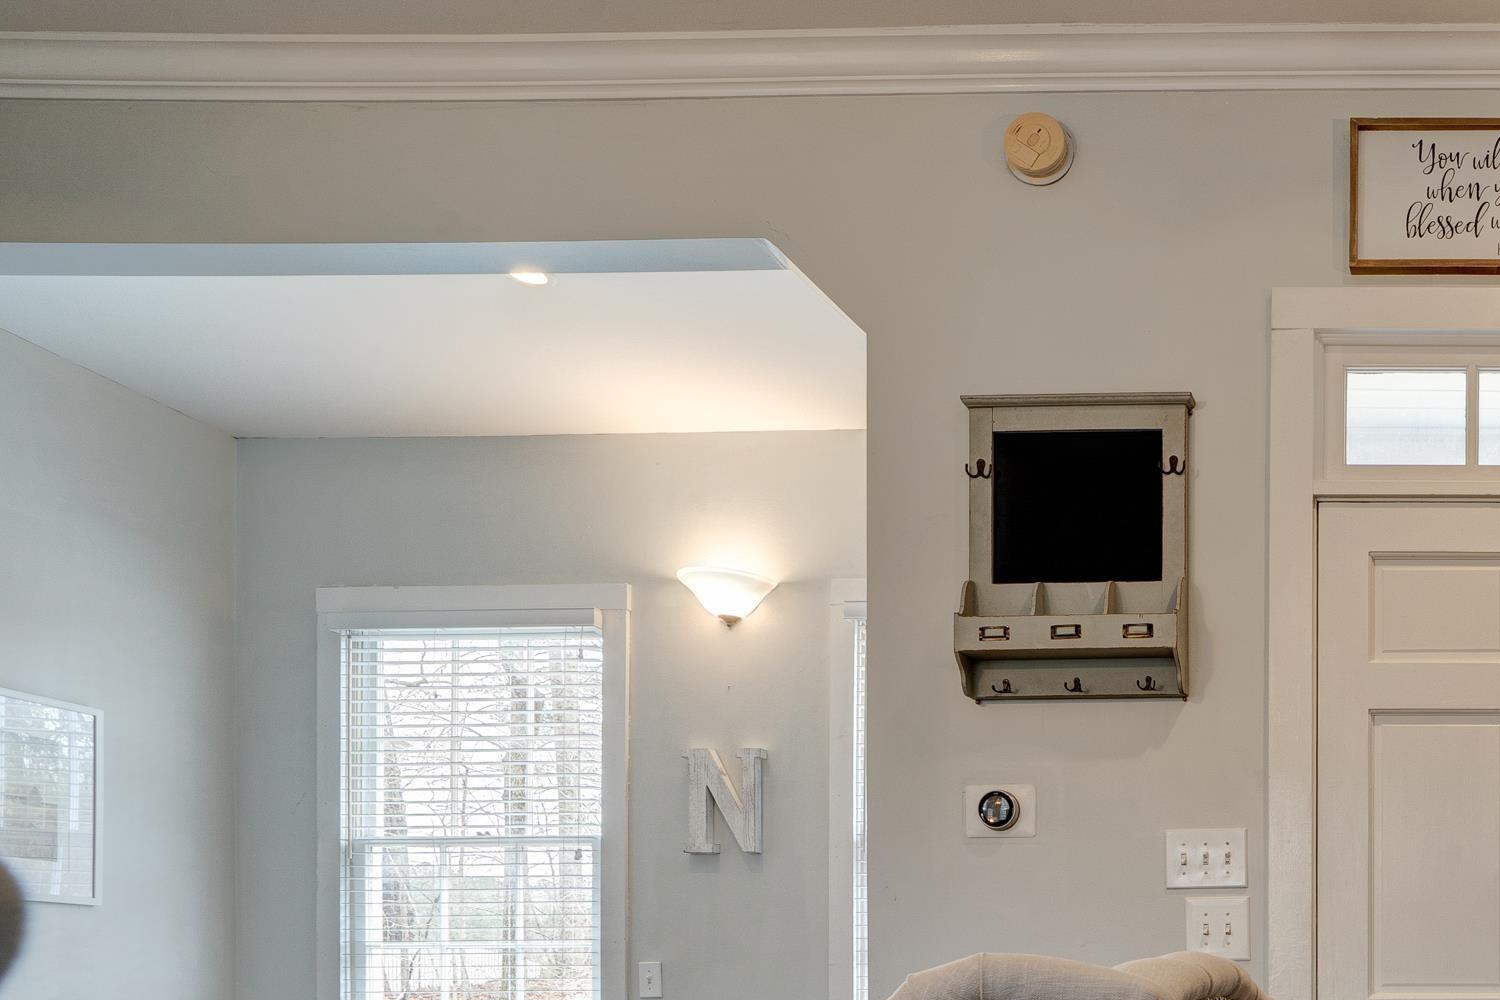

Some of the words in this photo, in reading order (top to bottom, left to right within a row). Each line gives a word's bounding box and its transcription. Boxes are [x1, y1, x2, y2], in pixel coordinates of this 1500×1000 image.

[1412, 138, 1470, 175] You
[1427, 168, 1490, 203] when
[1406, 201, 1490, 240] blessed
[681, 747, 768, 855] N
